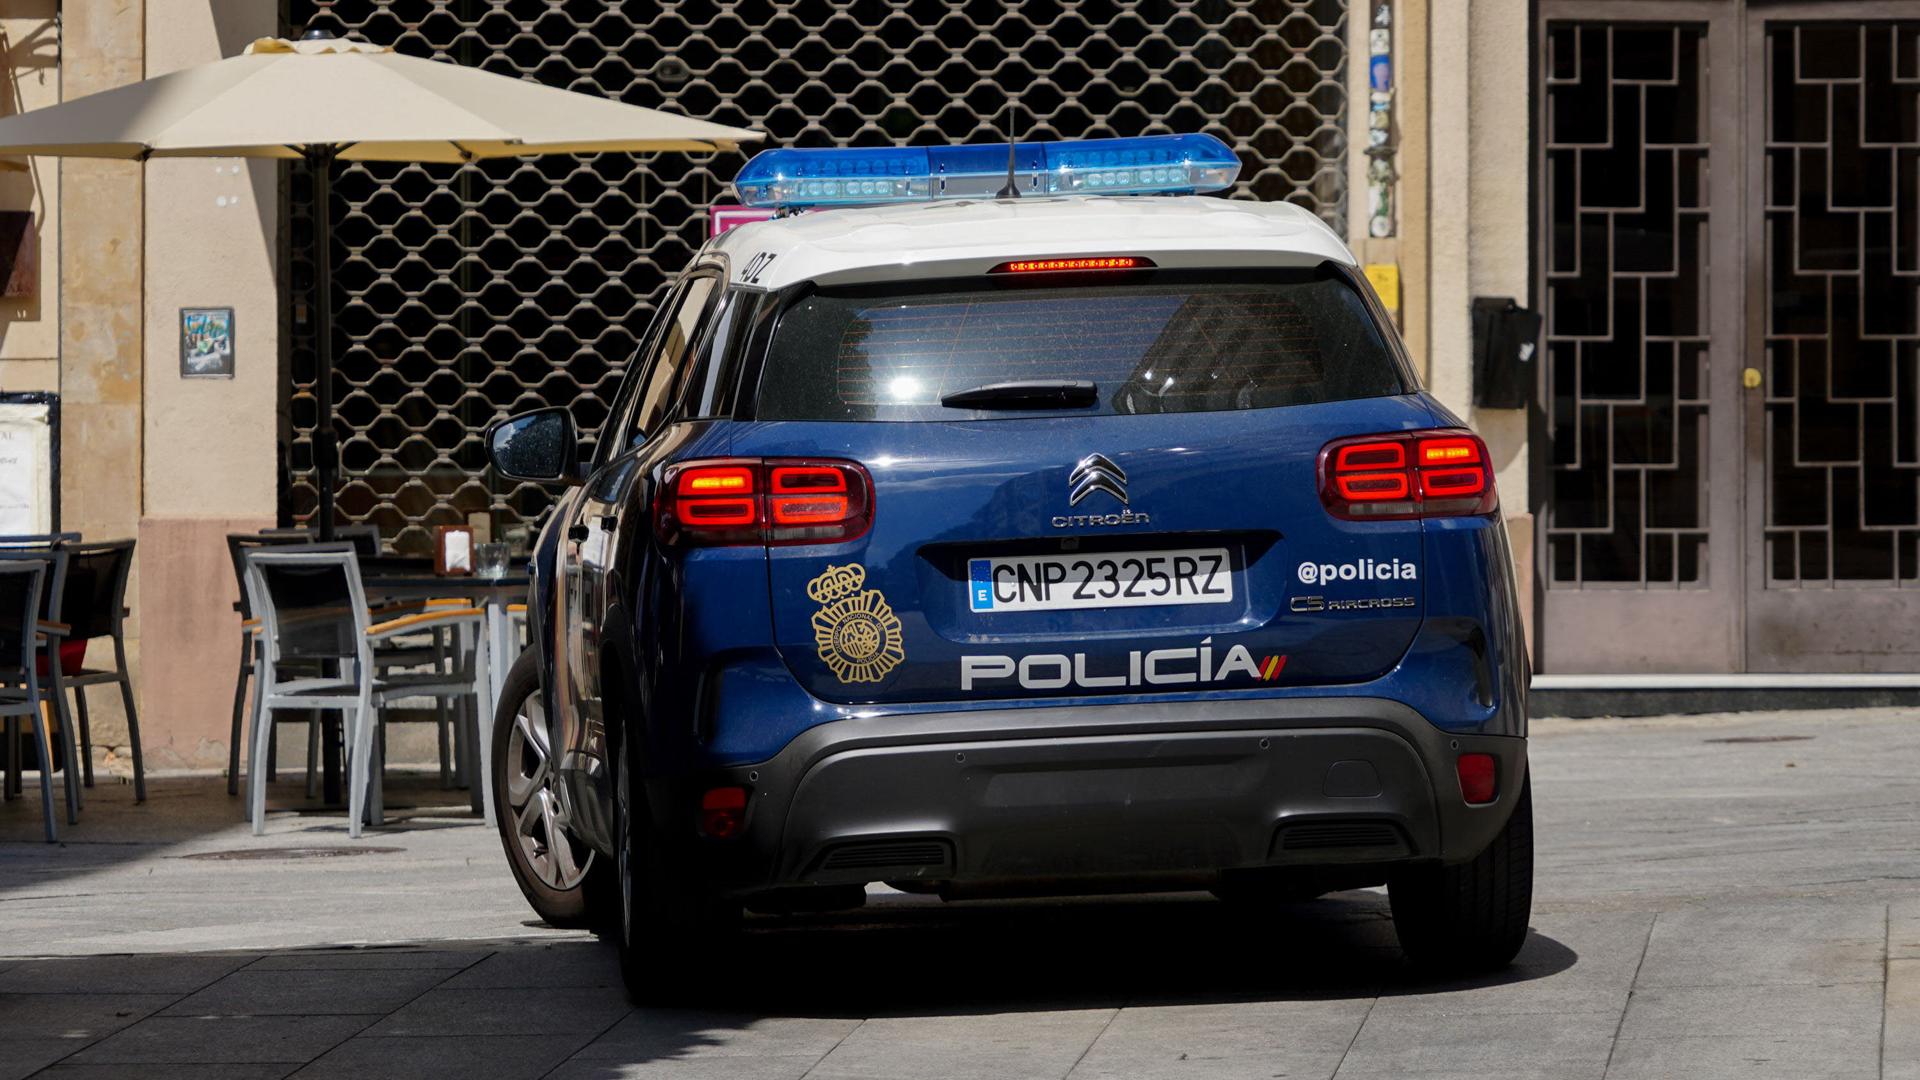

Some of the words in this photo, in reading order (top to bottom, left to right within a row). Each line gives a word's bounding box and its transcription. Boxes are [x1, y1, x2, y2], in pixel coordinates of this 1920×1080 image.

[978, 589, 987, 601] E
[992, 555, 1225, 603] CNP2325RZ
[1297, 558, 1417, 586] @policia
[1290, 596, 1325, 612] C5
[1328, 597, 1415, 610] AIRCROSS
[961, 636, 1262, 691] POLICÍA
